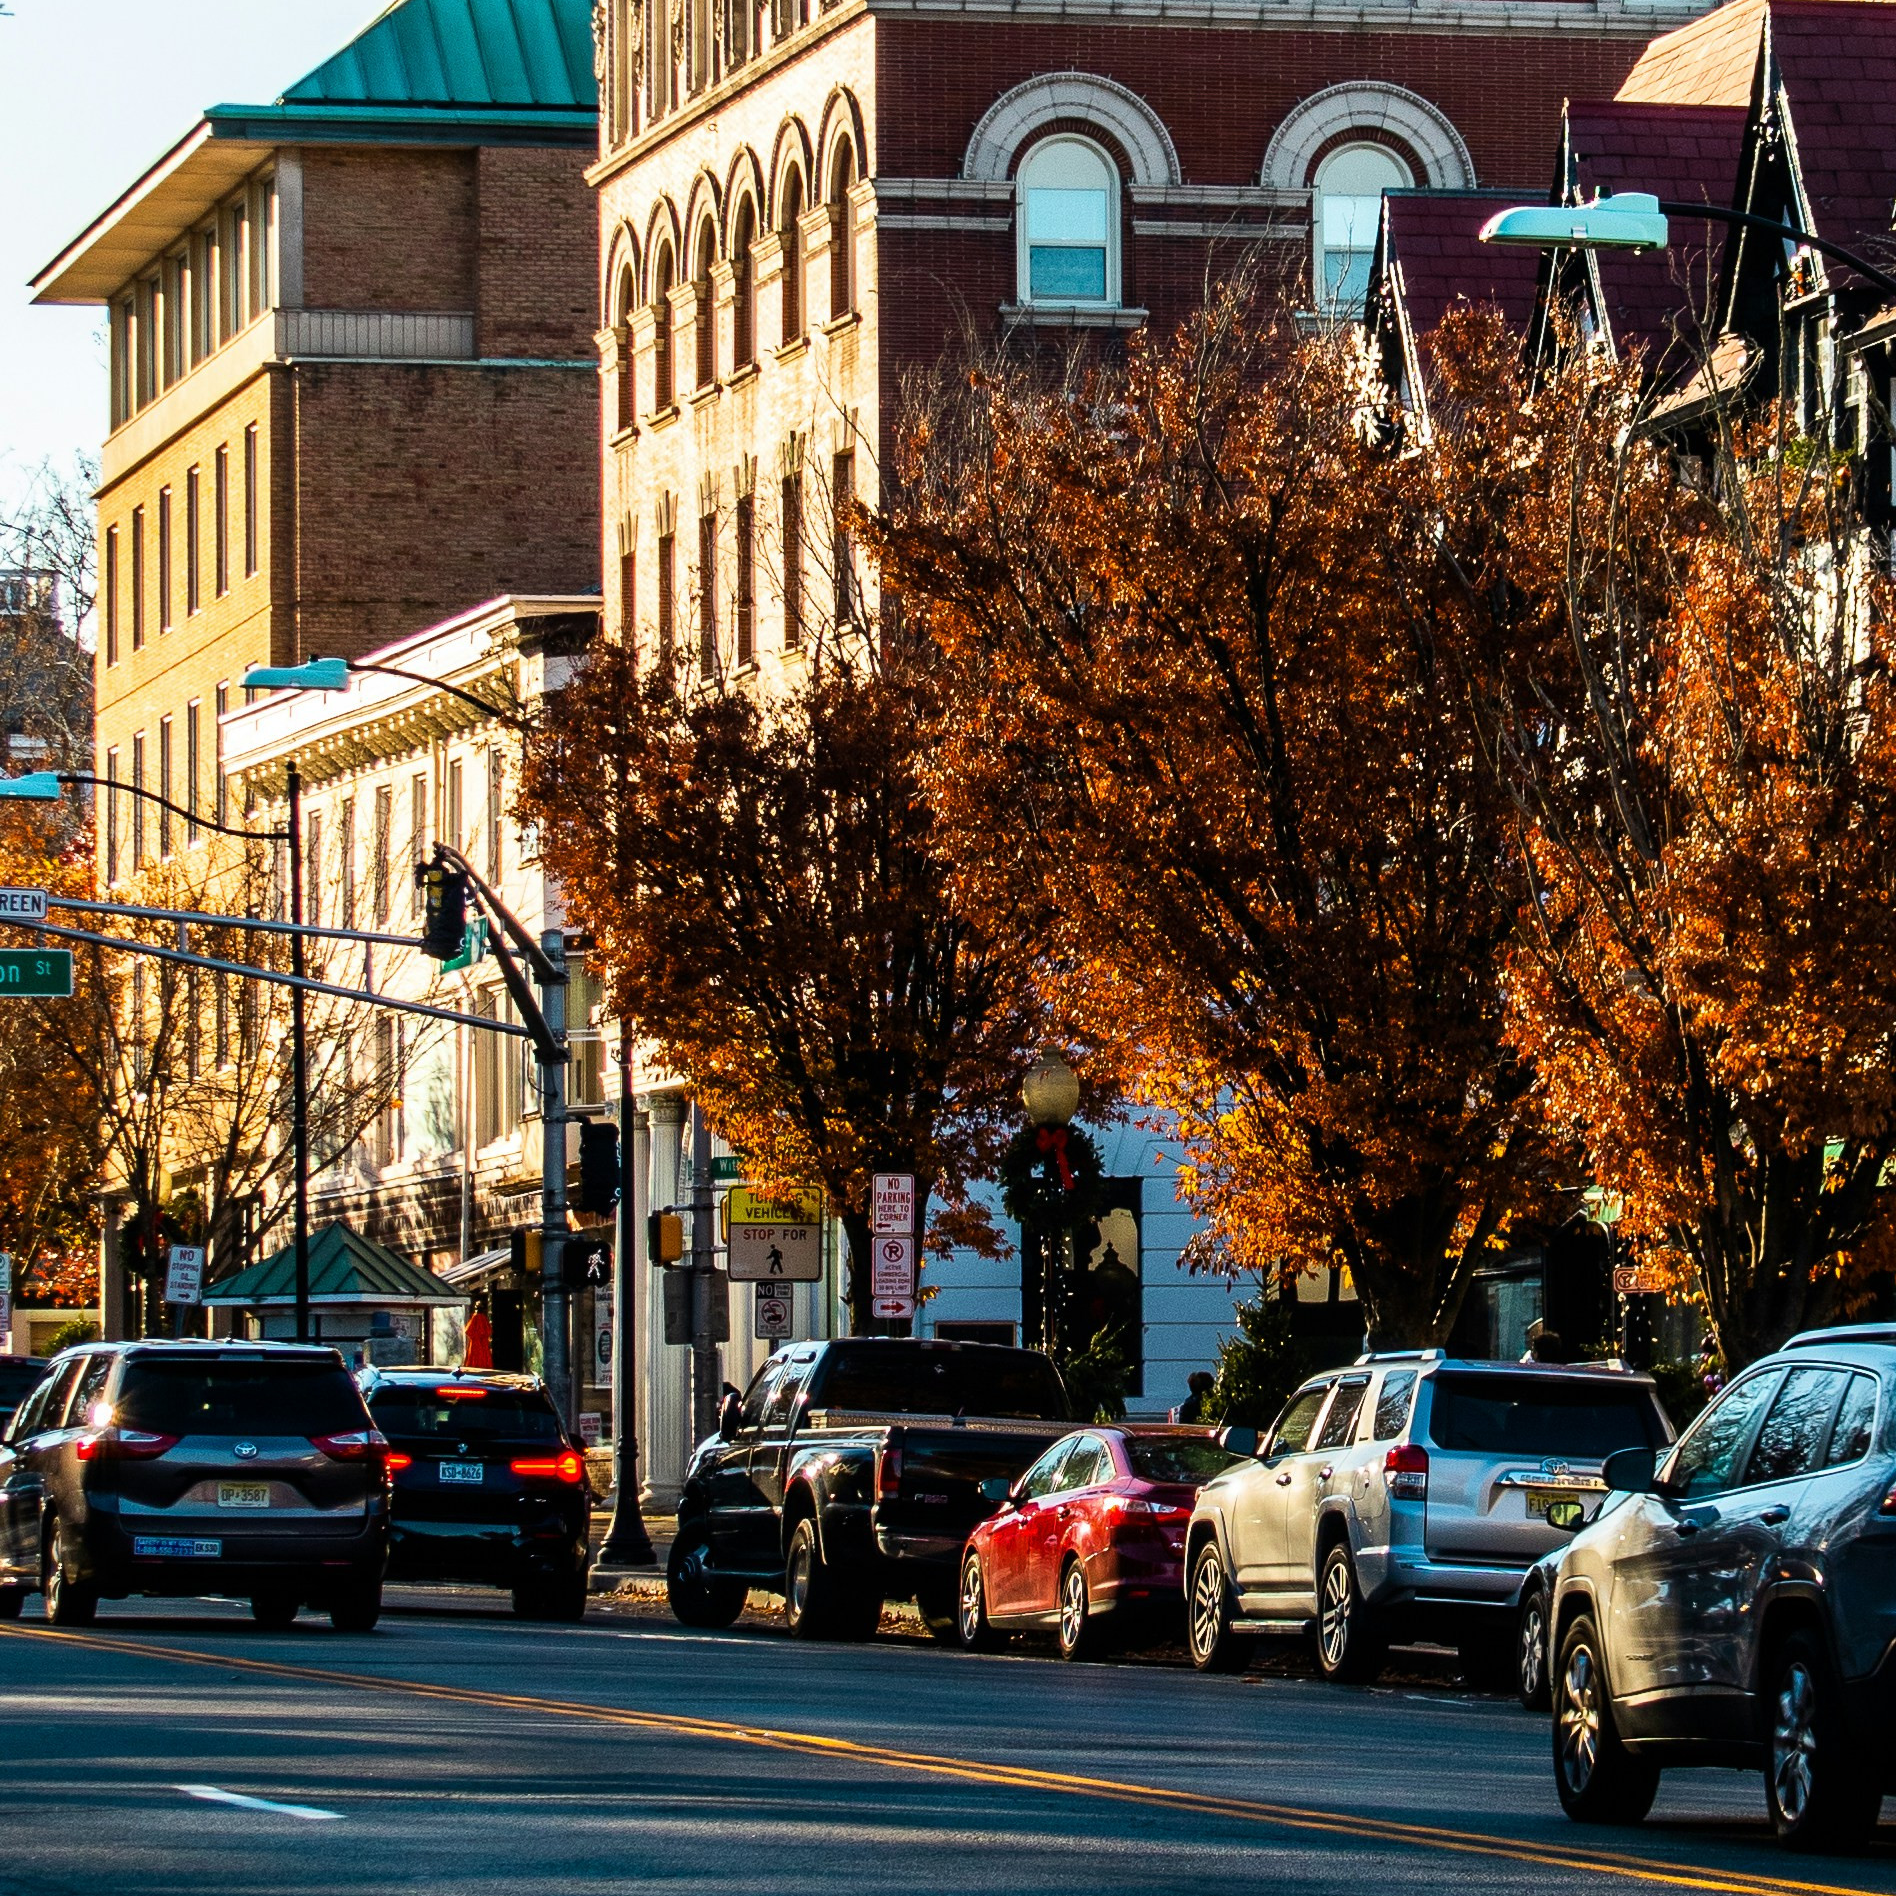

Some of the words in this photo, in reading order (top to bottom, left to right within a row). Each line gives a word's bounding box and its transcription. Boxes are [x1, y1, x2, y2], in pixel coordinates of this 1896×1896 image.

[36, 961, 51, 975] St
[888, 1178, 900, 1190] NO
[877, 1192, 910, 1204] PARKING
[878, 1205, 896, 1213] HERE
[900, 1205, 909, 1213] TO
[743, 1229, 775, 1241] STOP
[782, 1229, 807, 1241] FOR
[179, 1250, 194, 1261] NO
[757, 1285, 773, 1296] NO
